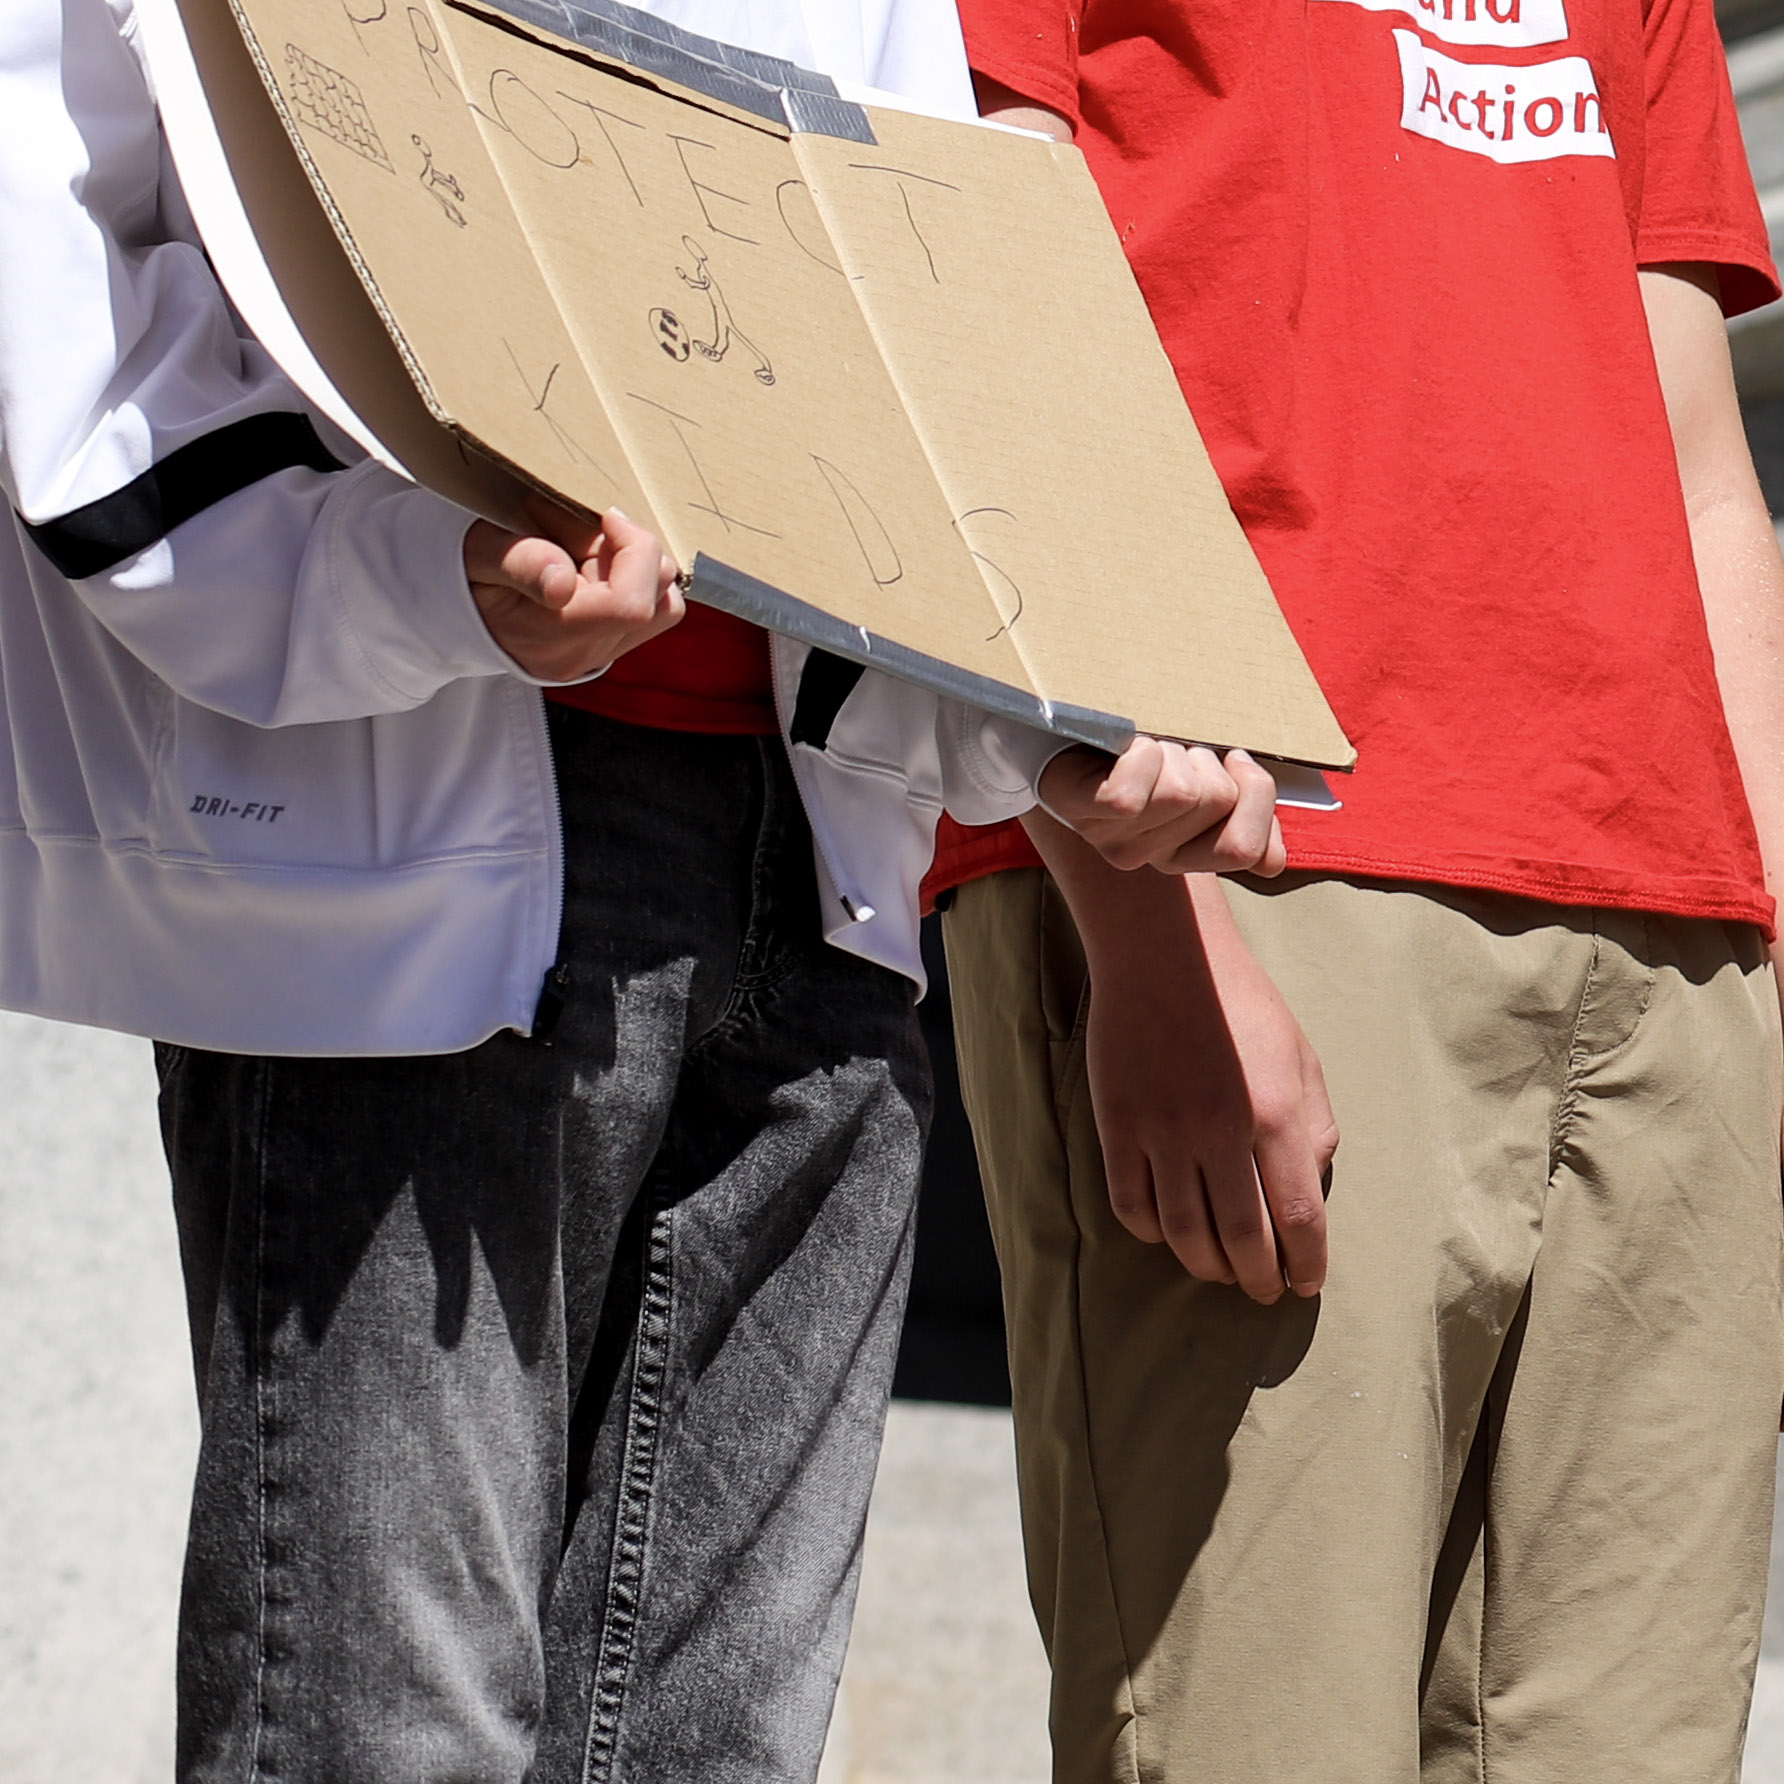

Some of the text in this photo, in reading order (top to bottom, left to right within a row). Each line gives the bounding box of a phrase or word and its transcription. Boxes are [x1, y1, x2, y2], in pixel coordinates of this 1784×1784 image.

[1419, 67, 1607, 142] Action
[502, 337, 1023, 642] KIDS
[190, 794, 286, 823] DRI-FIT
